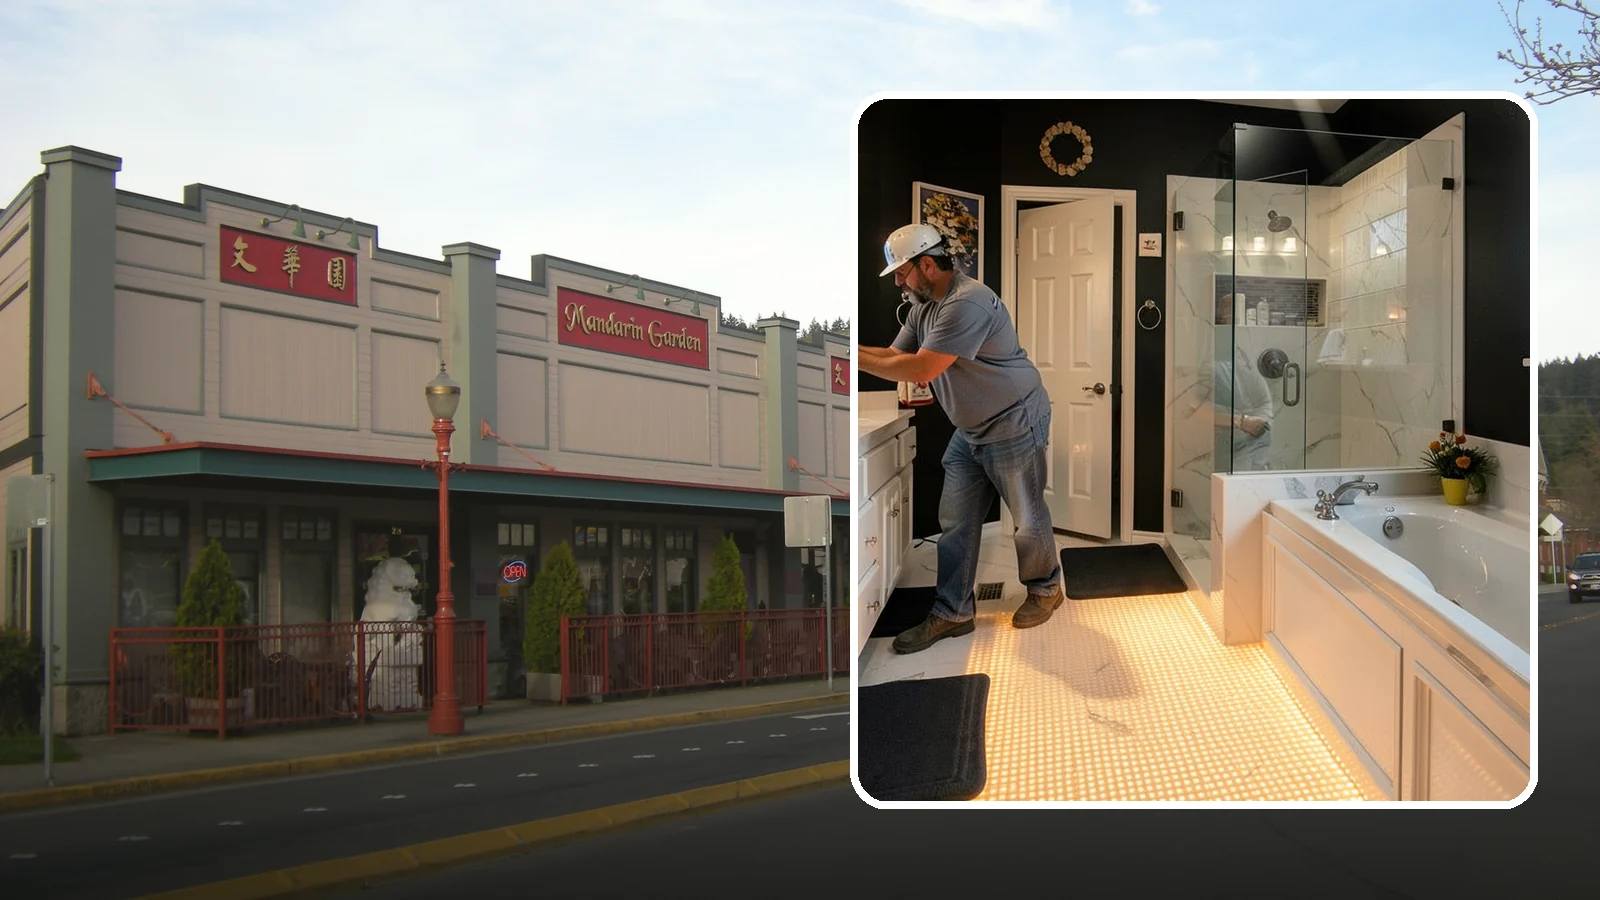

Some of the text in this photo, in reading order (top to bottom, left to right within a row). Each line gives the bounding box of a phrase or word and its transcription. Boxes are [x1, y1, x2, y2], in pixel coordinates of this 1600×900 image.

[231, 236, 346, 291] 文華園
[565, 302, 701, 352] Mandarin Garden
[503, 565, 527, 578] OPEN
